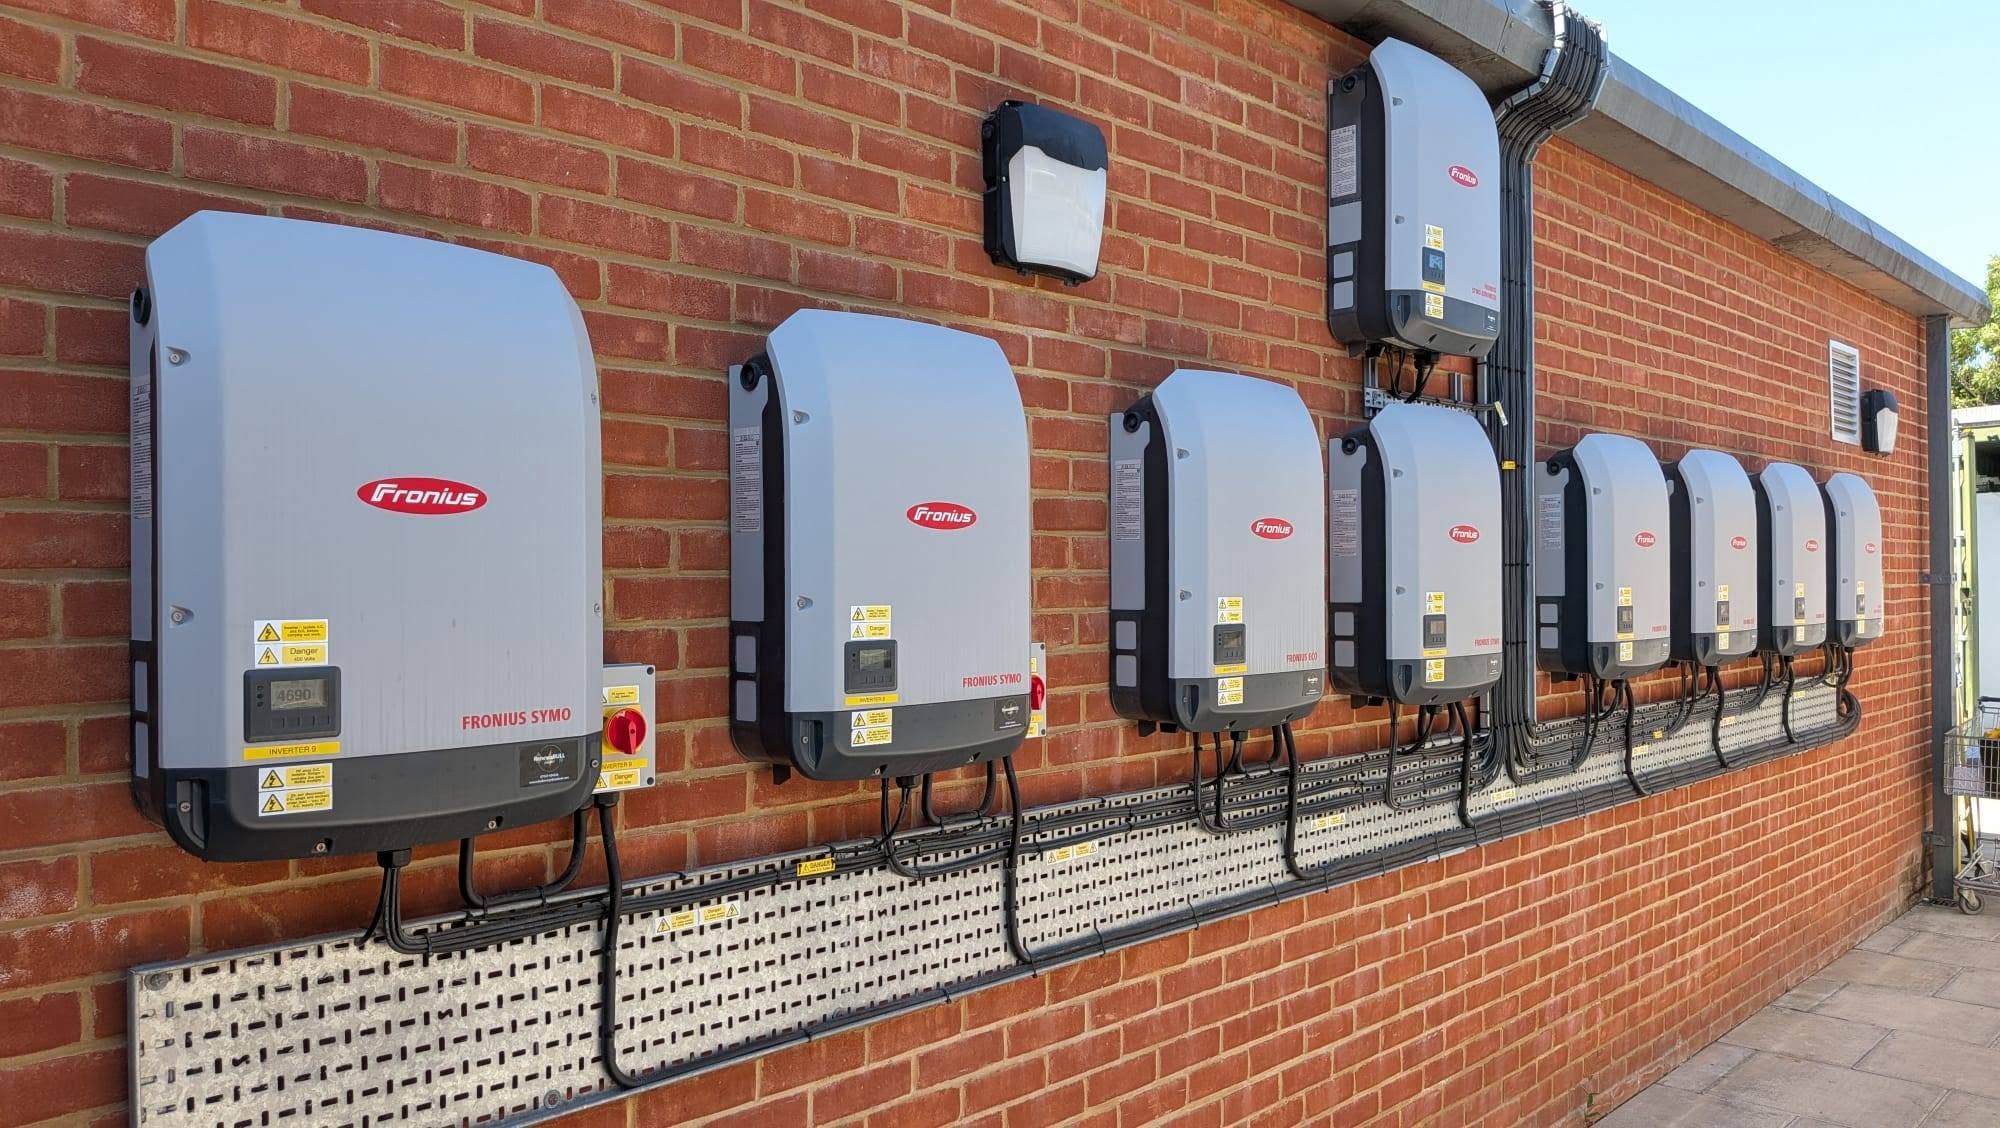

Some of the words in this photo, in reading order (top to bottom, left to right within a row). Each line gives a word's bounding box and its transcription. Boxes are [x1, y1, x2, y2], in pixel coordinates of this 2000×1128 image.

[371, 483, 479, 506] Fronius
[914, 506, 973, 523] Fronius
[1255, 521, 1291, 535] Fronius
[1452, 527, 1478, 539] Fronius
[289, 647, 319, 656] Danger
[962, 674, 998, 688] FRONIUS
[1000, 672, 1022, 685] SYMO
[279, 688, 312, 702] 4690
[462, 711, 527, 730] FRONIUS
[531, 707, 571, 724] SYMO
[269, 745, 310, 756] INVERTER
[602, 761, 628, 770] NVERTER
